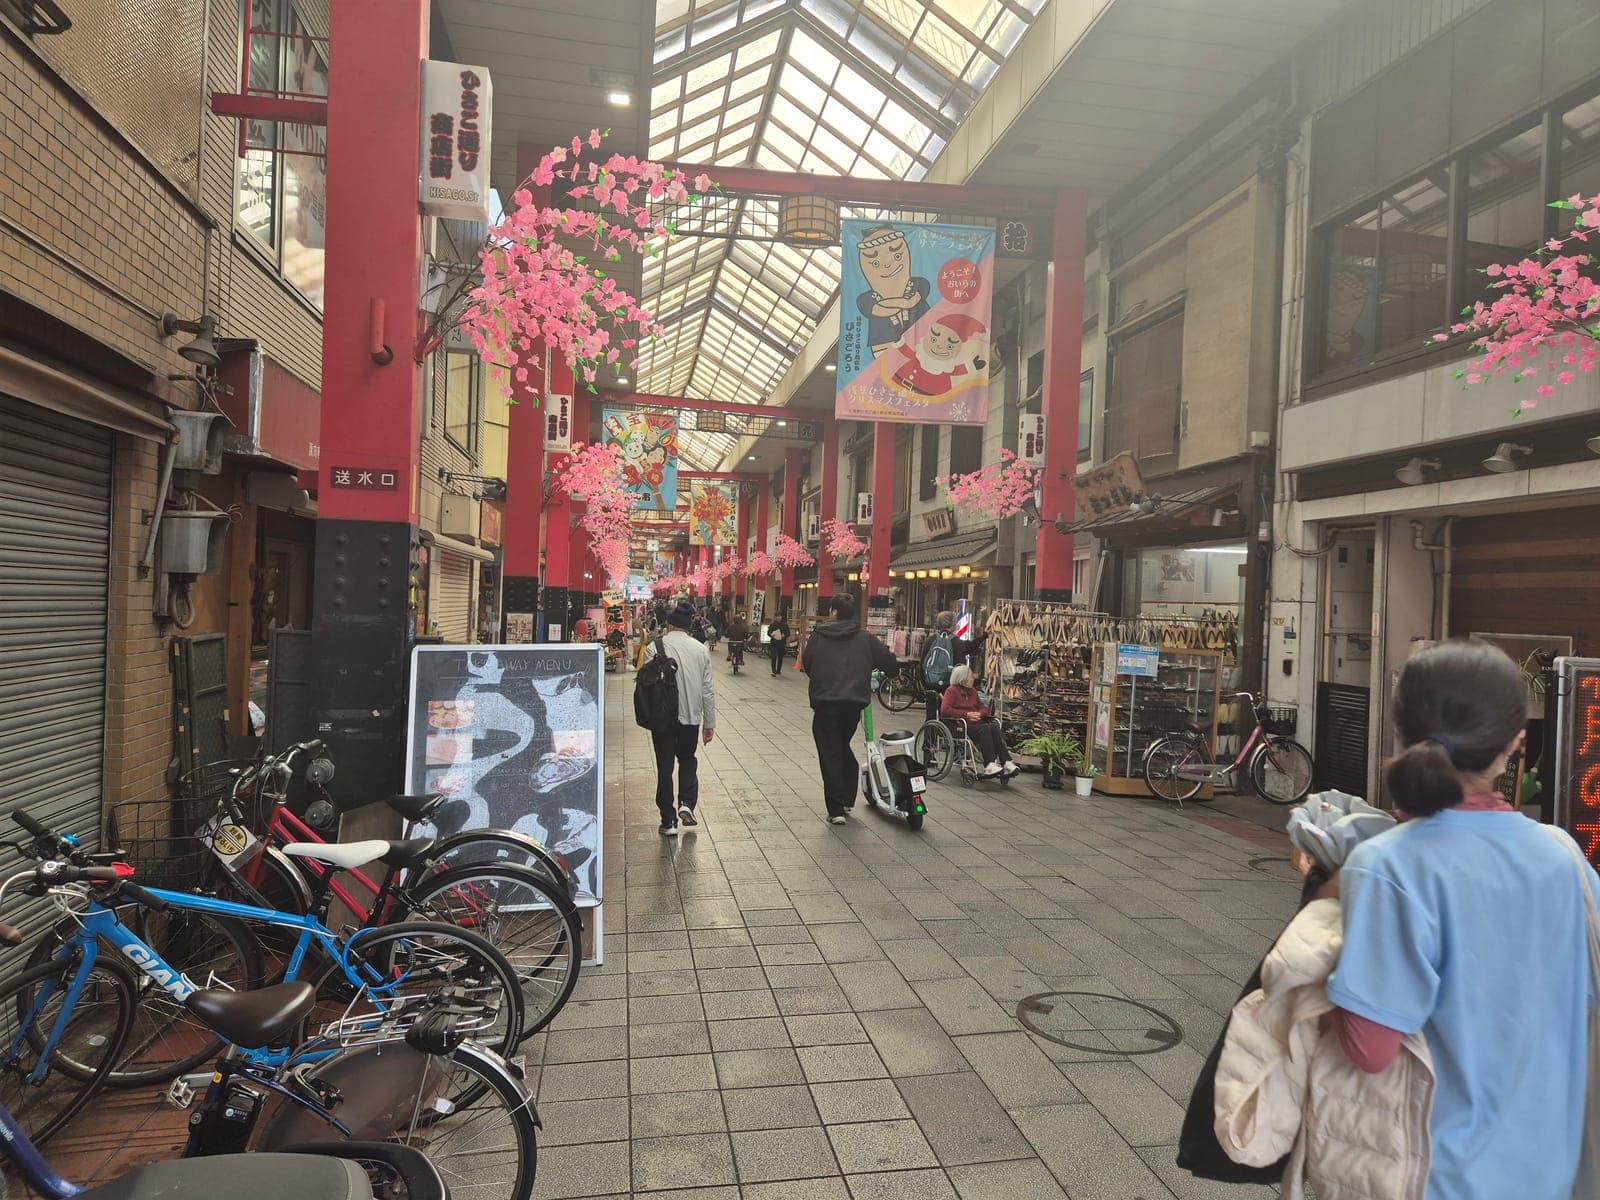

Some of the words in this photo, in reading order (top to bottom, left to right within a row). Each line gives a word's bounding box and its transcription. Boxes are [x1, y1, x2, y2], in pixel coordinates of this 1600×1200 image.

[458, 70, 480, 172] ひさご通り
[947, 280, 977, 289] おいらの
[848, 394, 930, 408] クリスマスフェスタ
[335, 469, 395, 486] 送水口
[535, 658, 573, 672] MENU
[122, 943, 193, 1002] GIAN
